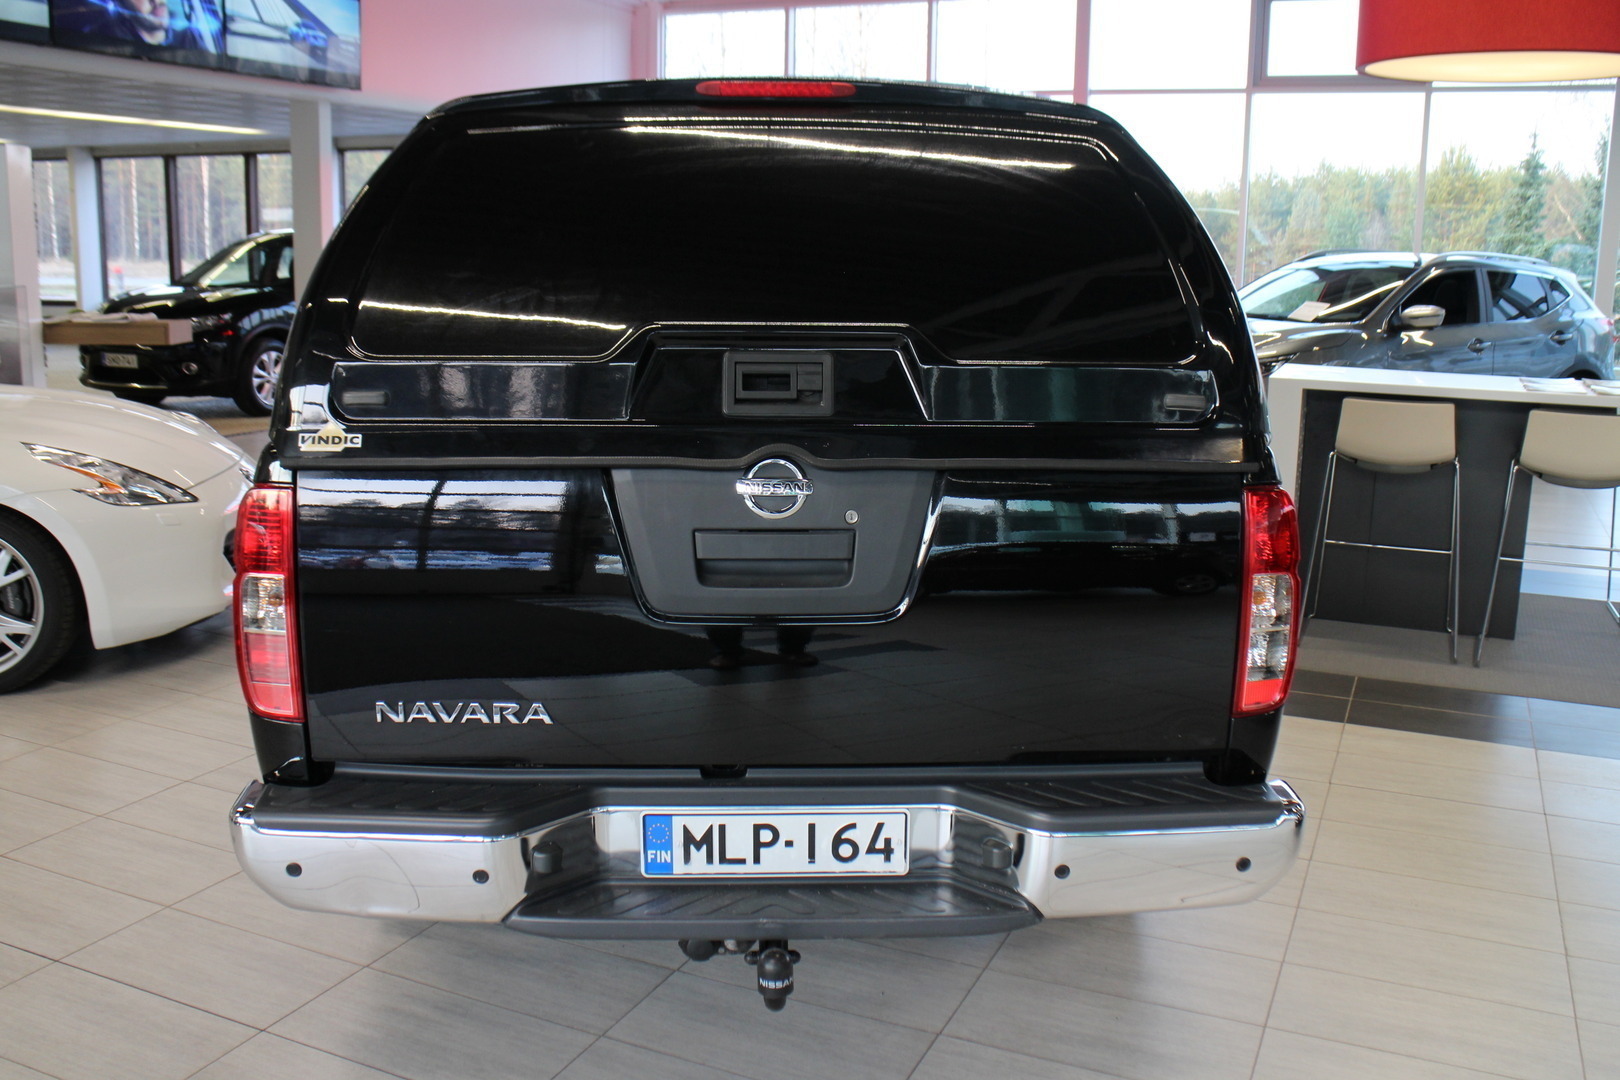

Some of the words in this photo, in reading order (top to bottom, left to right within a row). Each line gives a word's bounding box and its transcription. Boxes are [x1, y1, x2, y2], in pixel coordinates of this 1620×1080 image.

[300, 435, 360, 445] VINDIC
[744, 481, 806, 494] NISSAN
[375, 702, 554, 725] NAVARA
[682, 822, 895, 865] MLP-164
[647, 850, 671, 863] FIN
